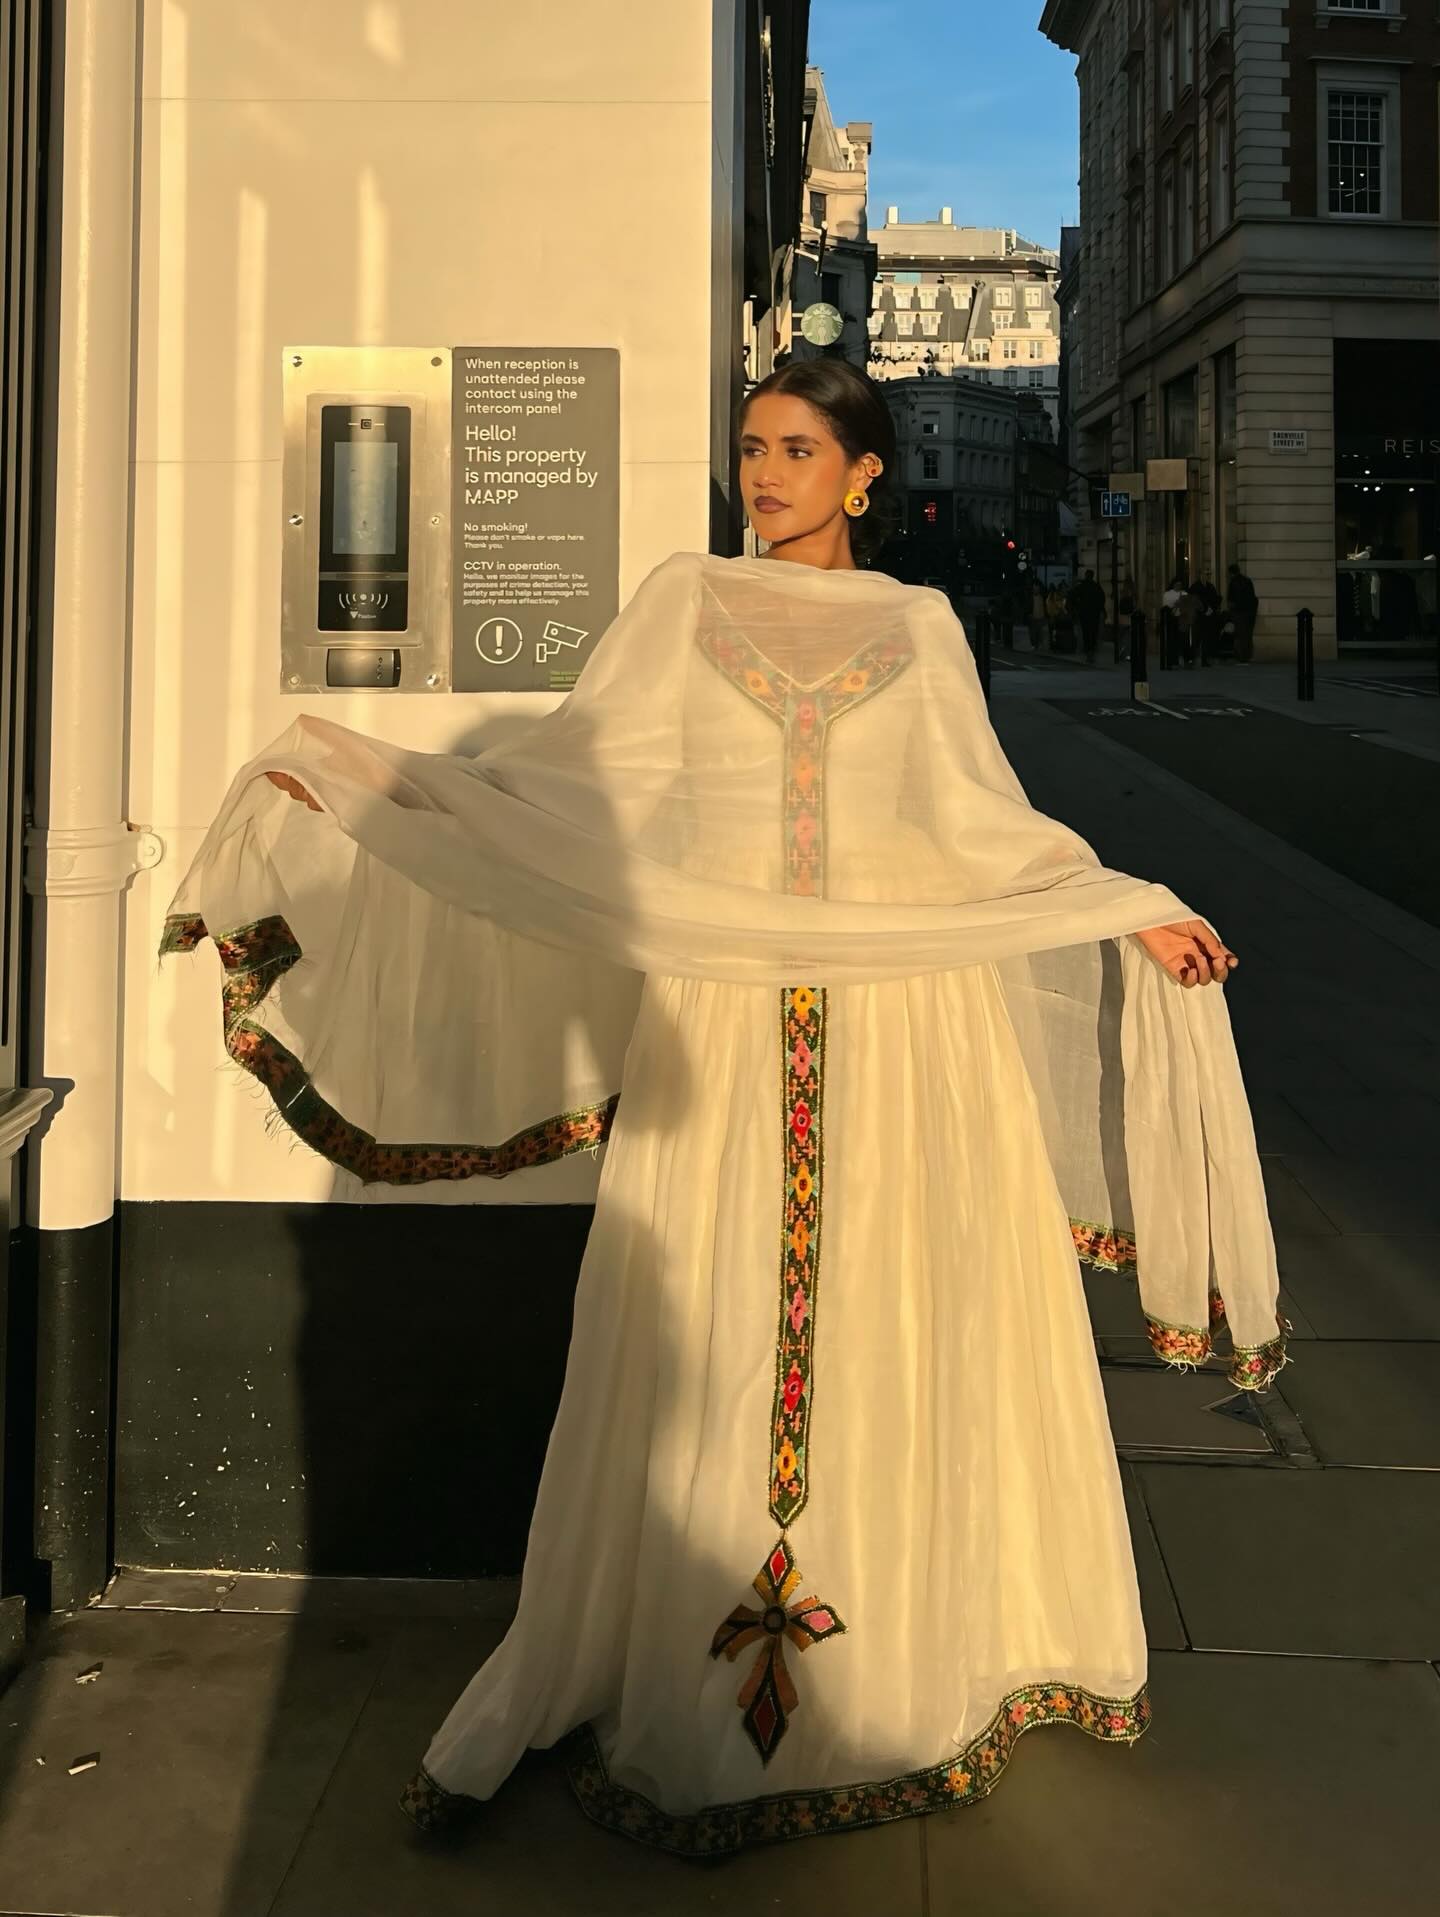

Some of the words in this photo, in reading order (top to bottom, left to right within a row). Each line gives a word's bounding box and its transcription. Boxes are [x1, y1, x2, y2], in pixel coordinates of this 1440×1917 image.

[465, 358, 501, 370] When
[504, 358, 566, 373] reception
[568, 358, 579, 370] is
[465, 373, 540, 385] unattended
[543, 373, 586, 388] please
[465, 388, 517, 399] contact
[519, 388, 553, 402] using
[556, 388, 578, 400] the
[465, 402, 523, 414] intercom
[526, 402, 562, 417] panel
[466, 424, 517, 441] Hello!
[465, 446, 502, 463] This
[506, 447, 587, 467] property
[465, 467, 479, 484] is
[483, 466, 572, 488] managed
[575, 466, 599, 488] by
[465, 489, 519, 505] MAPP
[464, 522, 479, 532] No
[481, 522, 528, 534] smoking!
[463, 533, 489, 541] Please
[546, 535, 566, 543] vape
[464, 541, 487, 549] Thank
[463, 561, 494, 571] CCTV
[496, 561, 506, 571] in
[508, 561, 562, 573] operation.
[530, 573, 558, 582] images
[558, 572, 571, 580] for
[463, 582, 499, 590] purposes
[571, 582, 590, 590] your
[463, 590, 488, 598] safety
[488, 589, 505, 597] and
[514, 589, 532, 598] help
[543, 590, 575, 598] manage
[575, 589, 590, 597] this
[463, 598, 497, 607] property
